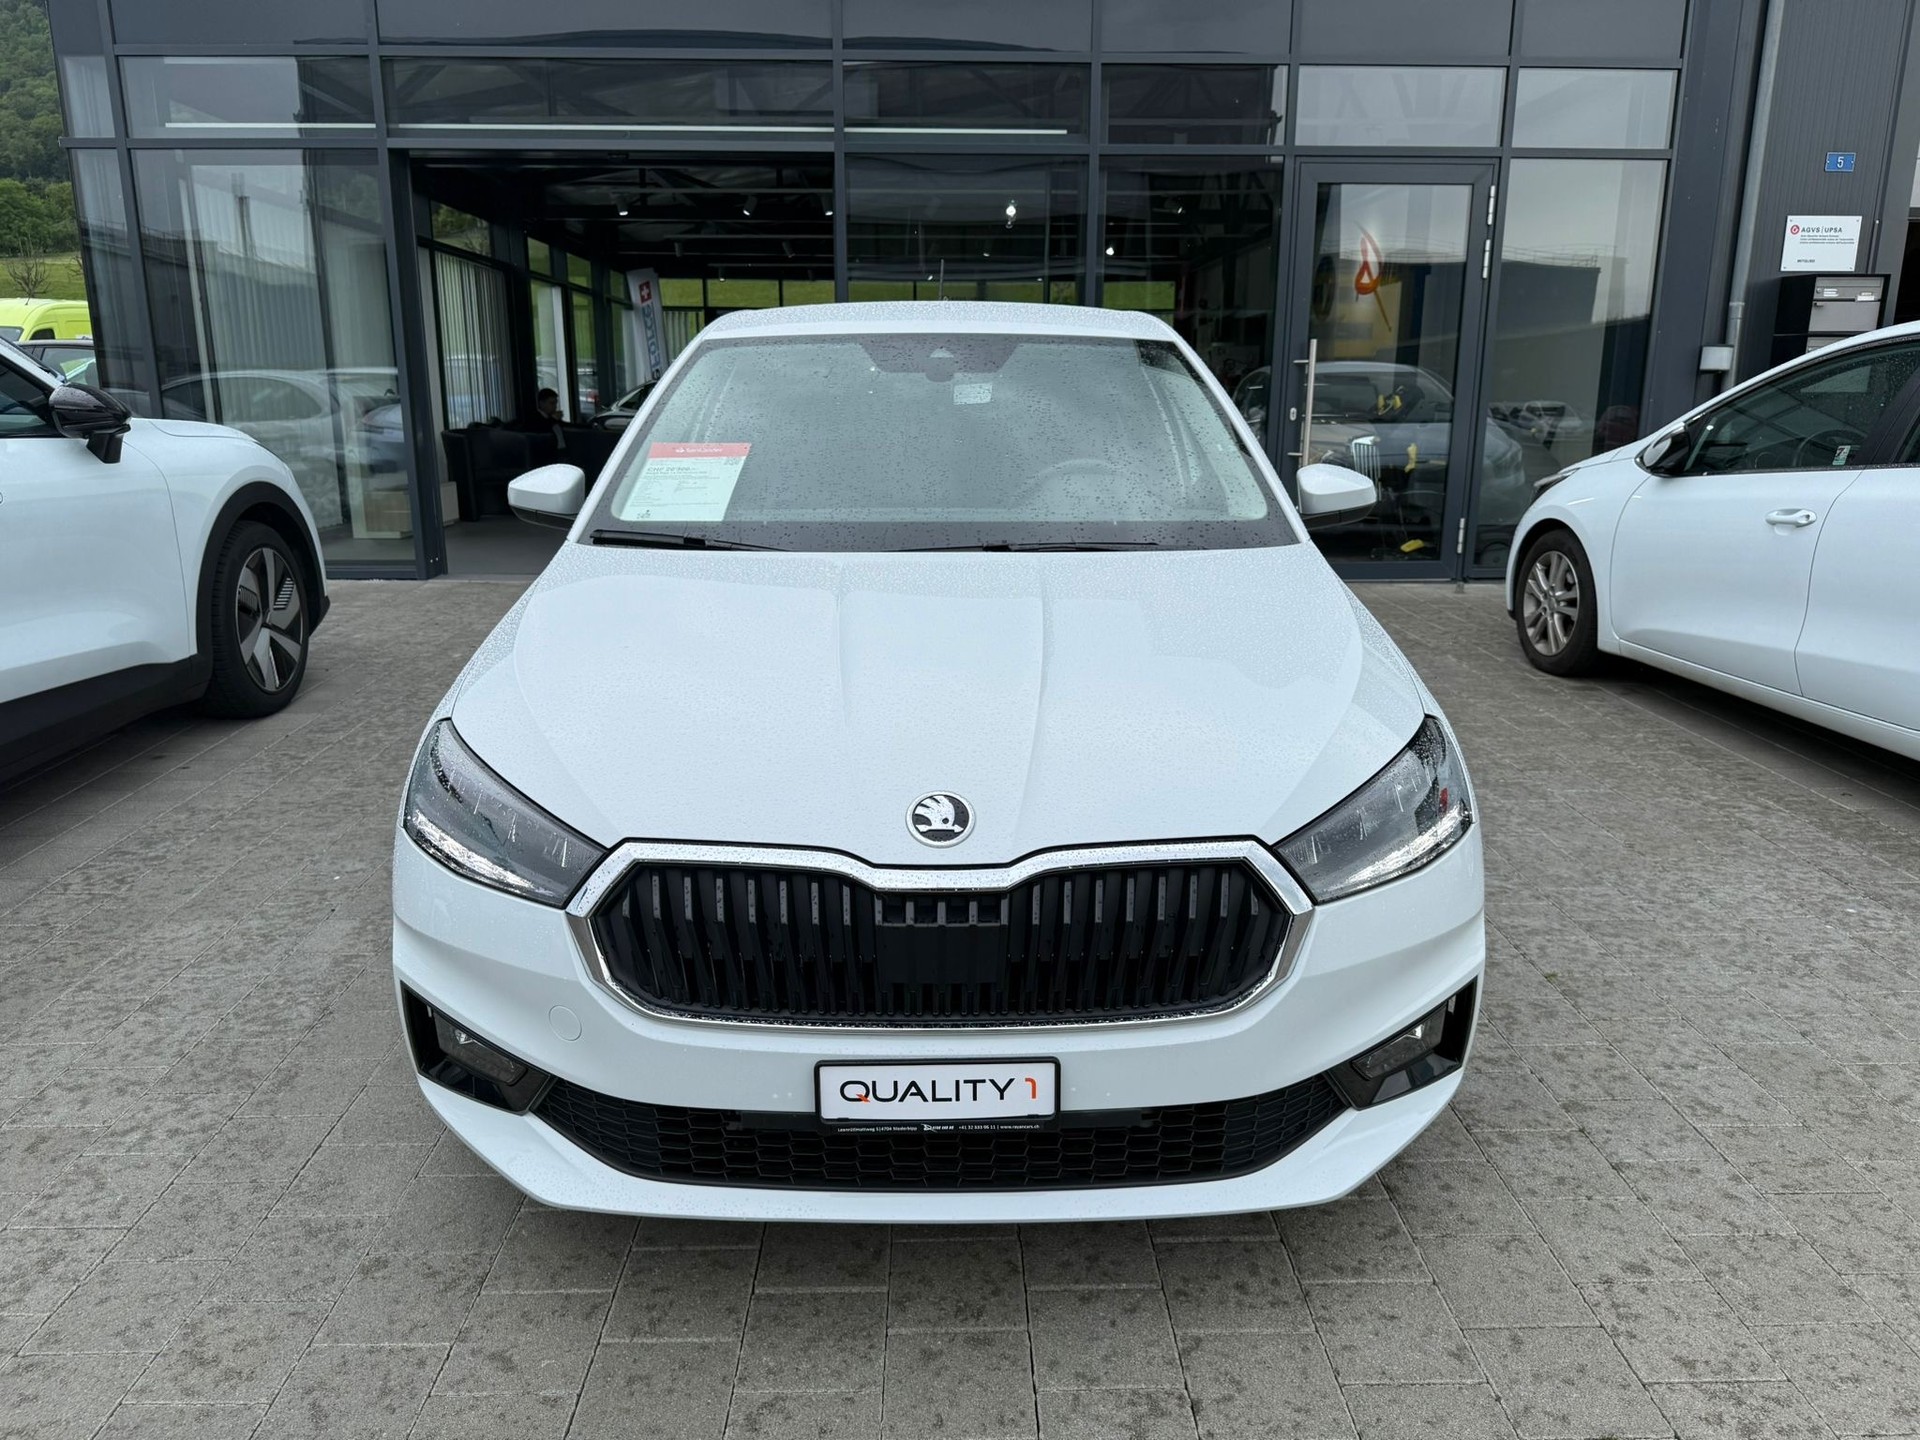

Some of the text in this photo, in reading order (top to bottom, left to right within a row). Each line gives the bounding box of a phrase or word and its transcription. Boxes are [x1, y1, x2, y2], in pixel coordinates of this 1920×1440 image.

[1837, 156, 1845, 169] 5
[839, 1077, 1037, 1103] QUALITY 1
